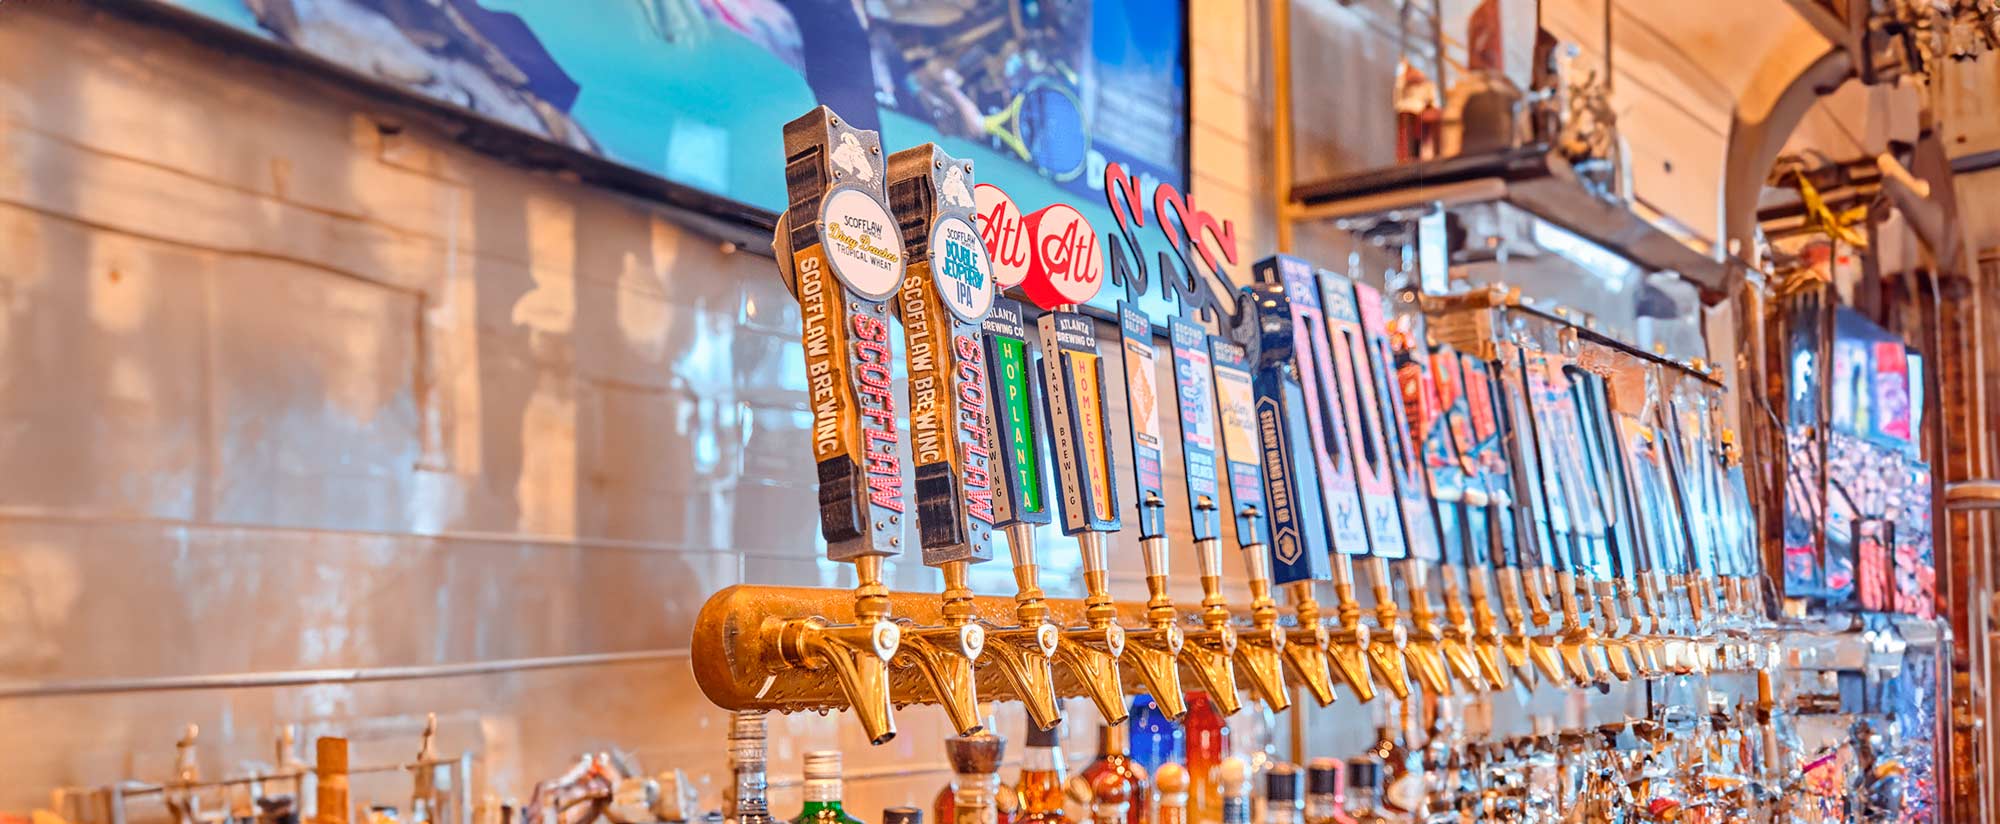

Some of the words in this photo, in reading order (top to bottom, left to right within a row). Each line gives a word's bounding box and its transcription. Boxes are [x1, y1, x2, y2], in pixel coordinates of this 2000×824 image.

[837, 242, 868, 263] TROPICAL
[870, 255, 892, 271] WHEAT
[844, 215, 883, 233] SCOFFLAW
[945, 228, 976, 244] SCOFFLAW
[945, 239, 978, 268] DOUBLE
[977, 201, 1026, 268] Atl
[1041, 218, 1098, 284] Atl
[800, 256, 829, 357] SCOFFLAW
[942, 257, 984, 290] JEOPARDY
[956, 281, 973, 308] IPA
[904, 275, 934, 372] SCOFFLAW
[982, 321, 1013, 336] BREWING
[1013, 327, 1023, 338] CO
[986, 307, 1017, 325] ATLANTA
[1056, 331, 1085, 347] BREWING
[1085, 337, 1095, 348] CO
[1060, 319, 1090, 336] ATLANTA
[810, 360, 838, 456] BREWING
[853, 313, 905, 514] SCOFFLAW
[914, 378, 940, 465] BREWING
[957, 335, 995, 526] SCOFFLAW
[1003, 342, 1032, 508] HOPLANTA
[1046, 338, 1062, 416] ATLANTA
[1059, 427, 1075, 506] BREWING
[1078, 359, 1105, 517] HOMESTAND
[985, 415, 1002, 498] BREWING
